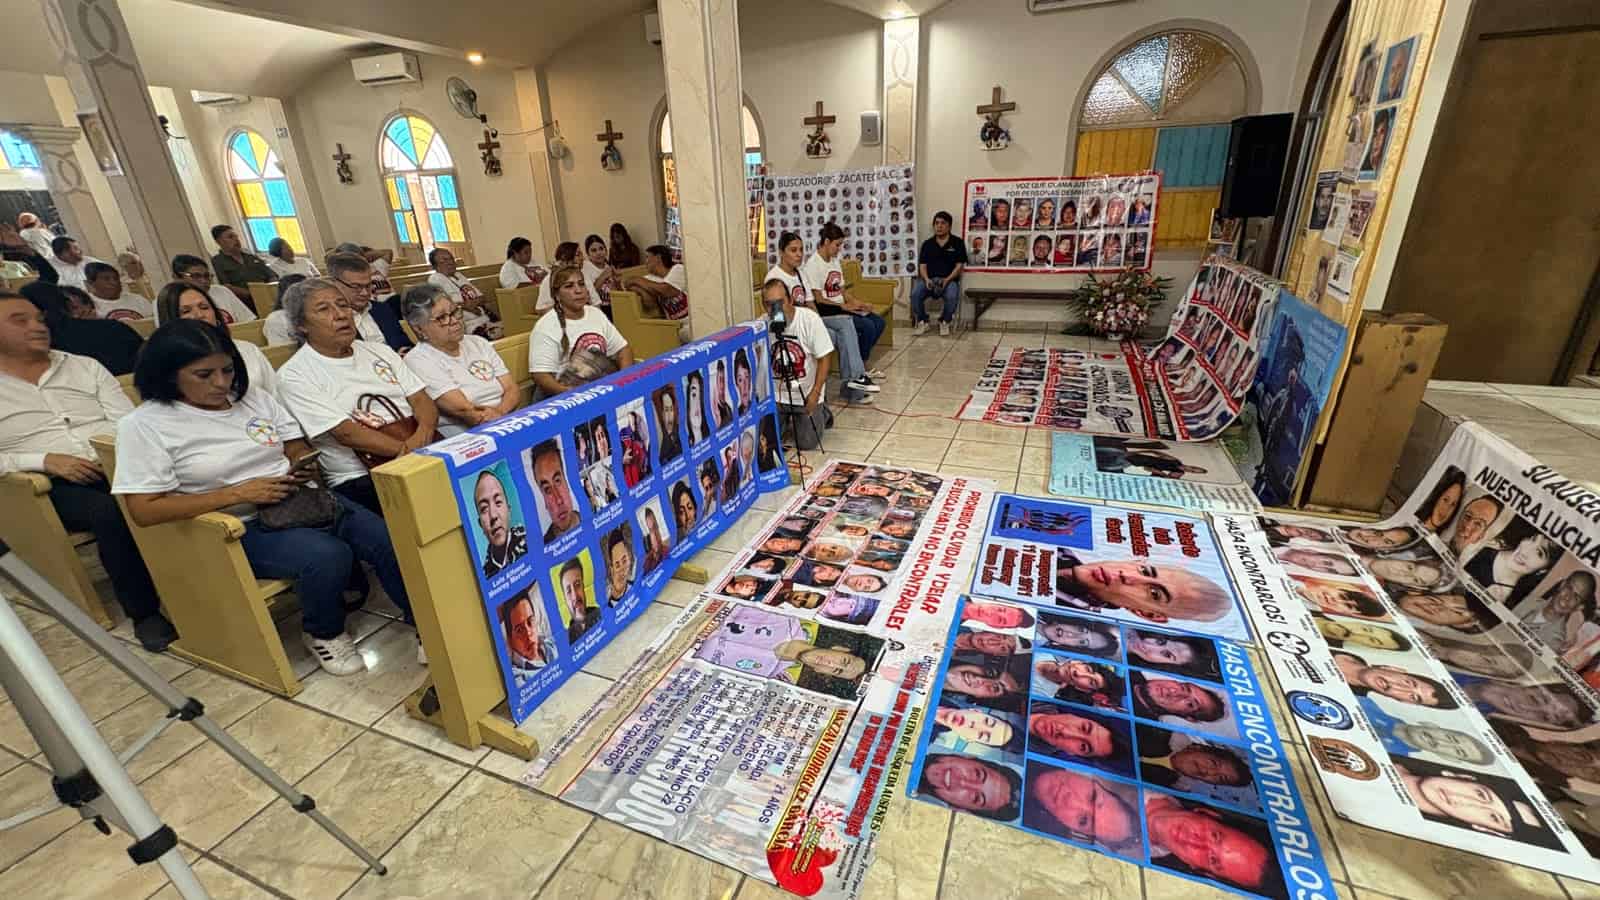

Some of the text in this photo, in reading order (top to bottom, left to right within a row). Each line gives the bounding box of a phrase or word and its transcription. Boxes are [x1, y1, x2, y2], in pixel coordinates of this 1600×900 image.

[1522, 465, 1559, 483] SU
[954, 490, 982, 529] PROHIBIDO
[1474, 466, 1600, 568] NUESTRA LUCHA
[923, 536, 941, 550] NO
[938, 530, 965, 569] OLVIDAR
[884, 551, 934, 630] ENCONTRARLES
[934, 572, 950, 582] Y
[1234, 544, 1288, 625] ENCONTRARLOS!
[1219, 640, 1256, 697] HASTA
[637, 703, 660, 722] LADO
[822, 708, 848, 744] HAZZAN
[638, 733, 664, 757] TIENE
[731, 727, 754, 756] CLARO
[738, 733, 765, 771] MORENO
[900, 732, 911, 746] DE
[610, 745, 640, 776] COLOR
[625, 757, 646, 776] UNA
[694, 753, 720, 783] CLARO
[794, 742, 832, 803] RODRIGUEZ
[885, 747, 908, 788] BUSQUEDA
[669, 763, 694, 791] JUNIO
[673, 784, 699, 814] LACIO
[870, 788, 894, 831] AUSENTES
